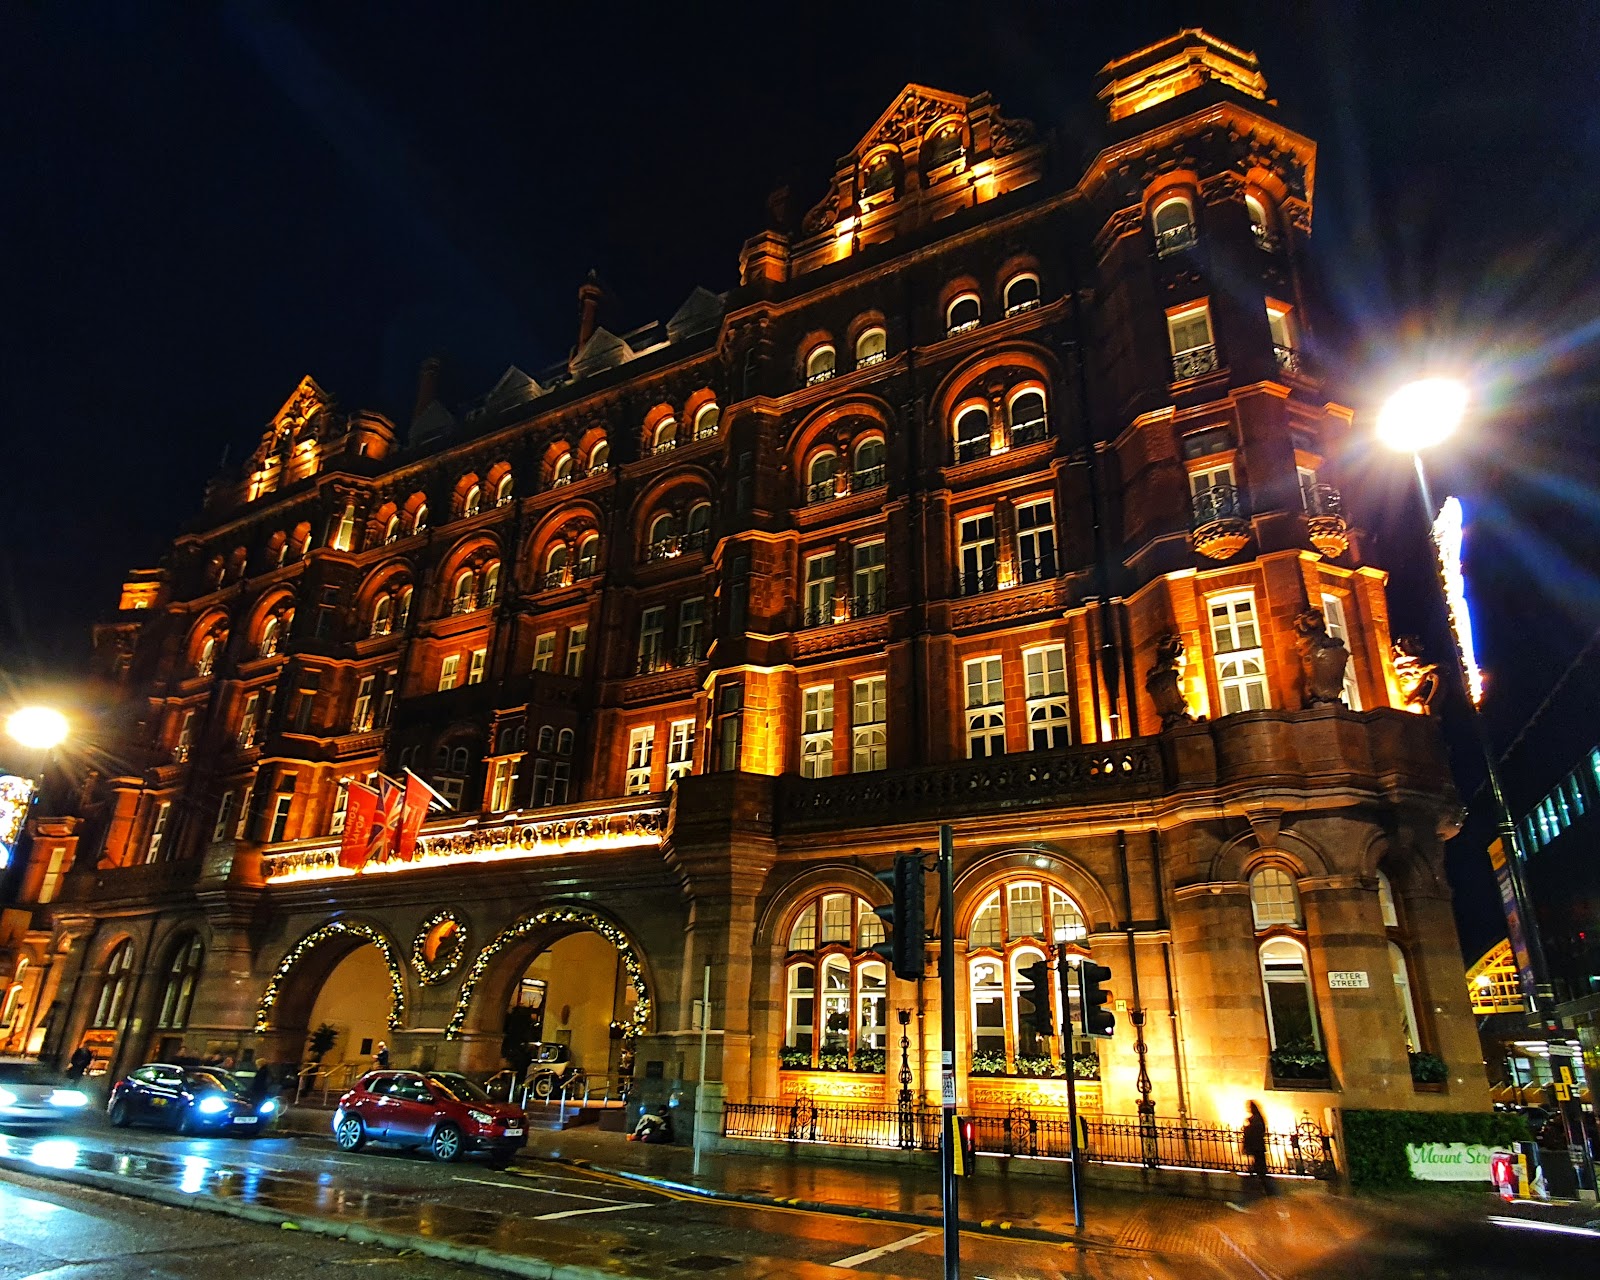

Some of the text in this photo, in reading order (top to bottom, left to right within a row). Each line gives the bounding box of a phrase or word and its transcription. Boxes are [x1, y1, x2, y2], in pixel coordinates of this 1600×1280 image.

[1334, 972, 1361, 980] PETER
[1413, 1146, 1490, 1164] Mount Str
